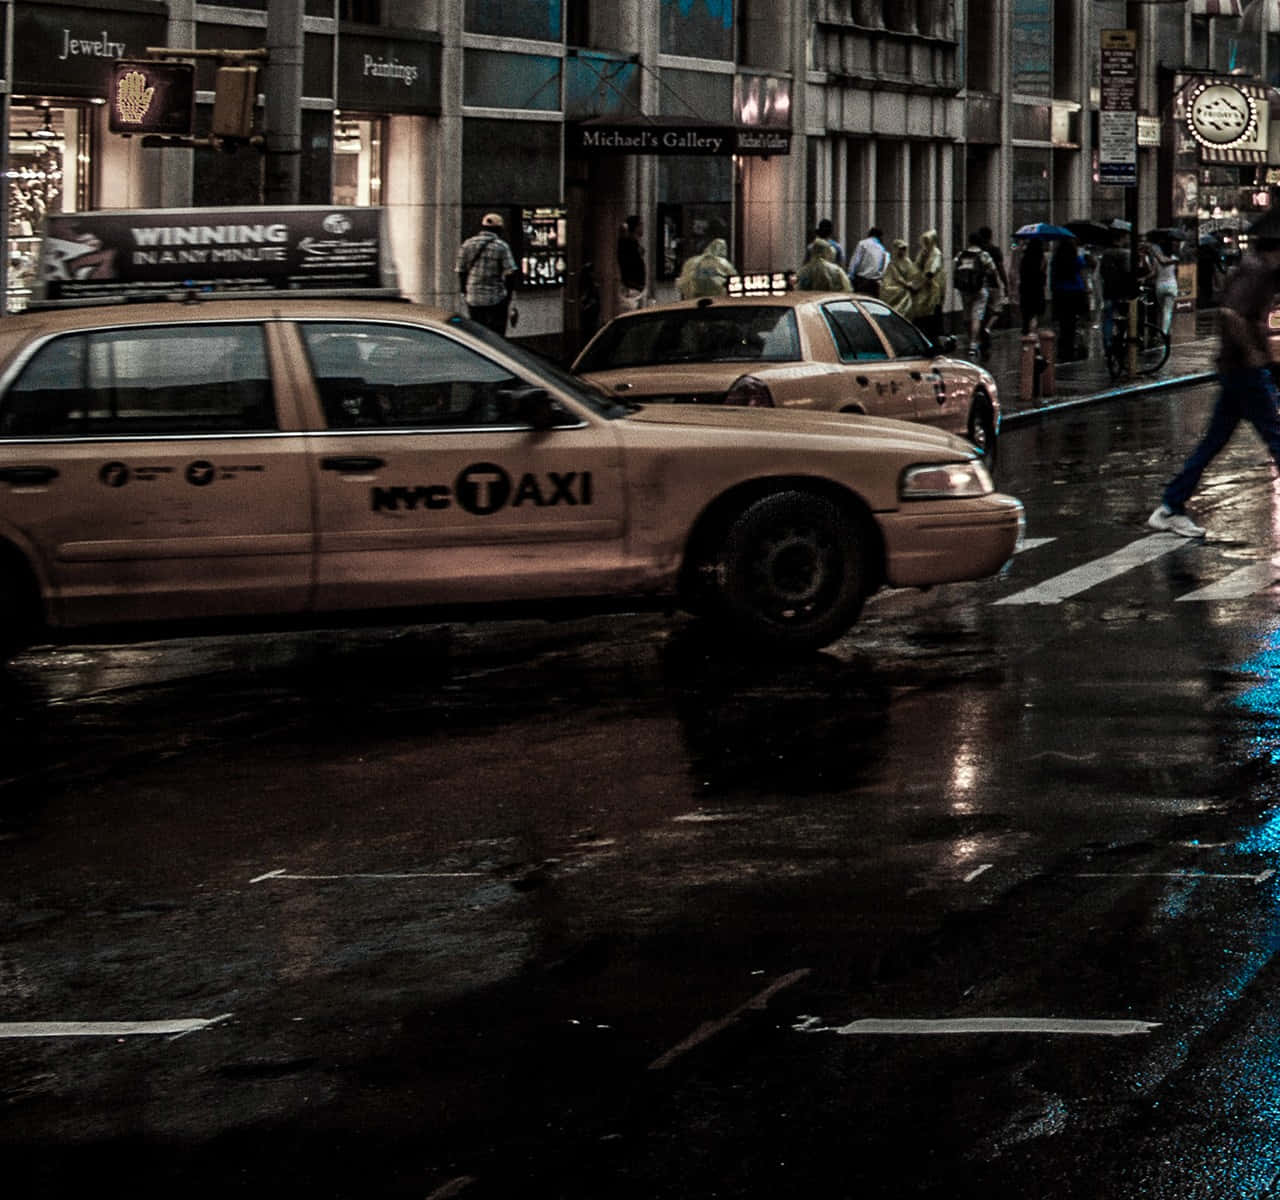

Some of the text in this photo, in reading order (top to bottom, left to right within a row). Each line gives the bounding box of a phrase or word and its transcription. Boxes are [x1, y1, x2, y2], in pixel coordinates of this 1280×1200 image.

[60, 29, 127, 60] Jewelry
[363, 54, 419, 87] Paintings
[582, 130, 724, 153] Michael's Gallery
[131, 224, 289, 247] WINNING
[132, 246, 288, 265] IN ANY MINUTE
[370, 466, 591, 513] NYC TAXI
